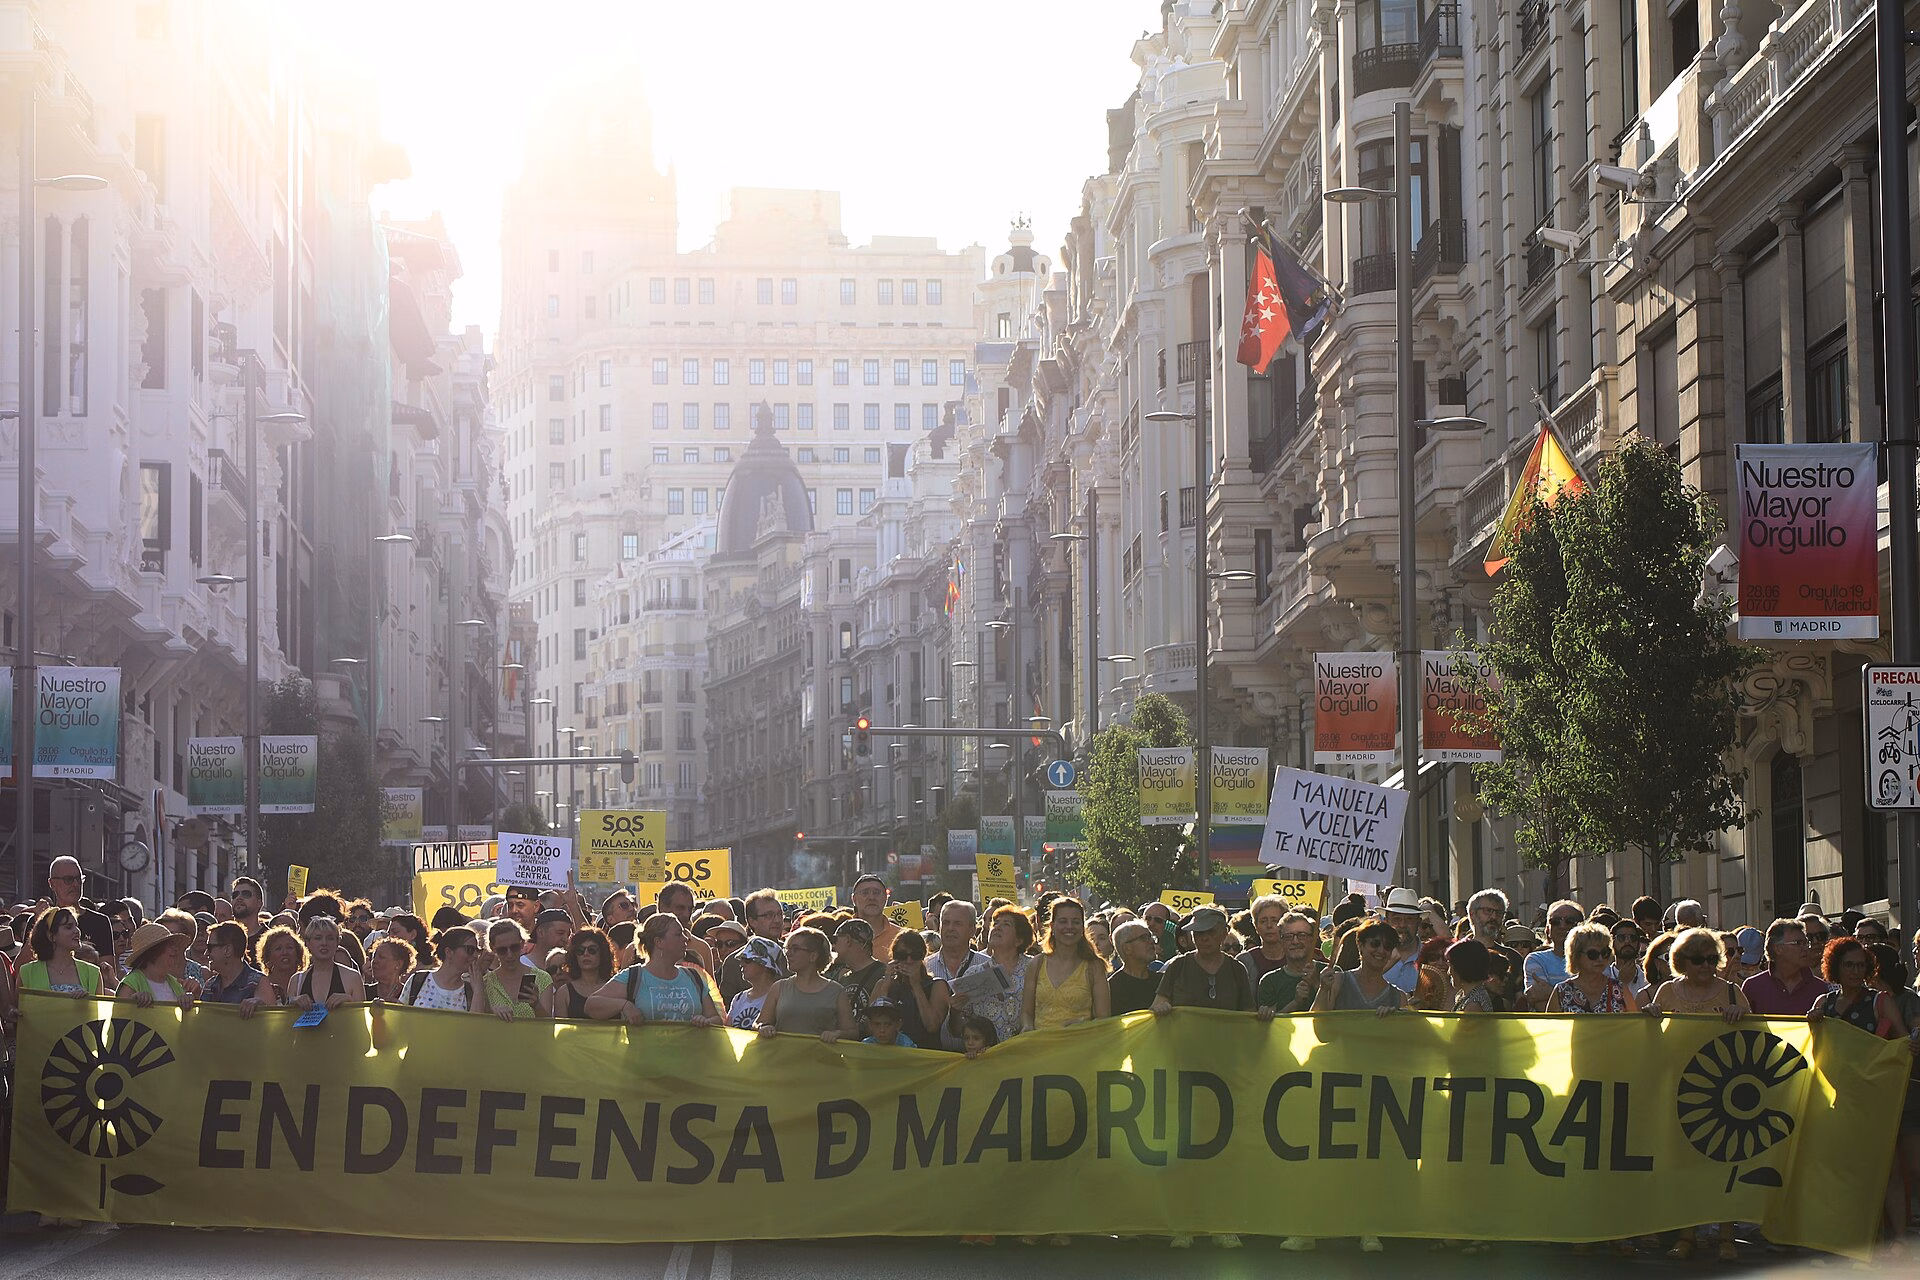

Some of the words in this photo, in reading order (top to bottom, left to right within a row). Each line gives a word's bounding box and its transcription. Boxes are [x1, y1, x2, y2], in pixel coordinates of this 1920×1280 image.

[1743, 460, 1855, 488] Nuestro
[1745, 490, 1832, 525] Mayor
[1749, 519, 1847, 555] Orgullo
[1746, 584, 1780, 598] 28.06
[1799, 584, 1848, 600] Orgullo
[1850, 584, 1864, 597] 19
[1746, 599, 1779, 611] 07.07
[1824, 598, 1872, 611] Madrid
[1790, 621, 1841, 632] MADRID
[1318, 662, 1383, 679] Nuestro
[1425, 660, 1492, 677] Nuero
[41, 676, 106, 693] Nuestro
[1873, 671, 1920, 685] PRECAU
[1319, 679, 1370, 699] Mayor
[40, 693, 92, 713] Mayor
[1319, 696, 1378, 716] Orgullo
[40, 709, 99, 730] Orgullo
[69, 746, 98, 757] Orgullo
[190, 743, 236, 755] Nuestro
[263, 742, 308, 754] Nuestro
[84, 755, 112, 763] Madrid
[190, 755, 227, 769] Mayor
[263, 754, 299, 768] Mayor
[1140, 754, 1186, 766] Nuestro
[1213, 753, 1259, 766] Nuestro
[1345, 753, 1376, 761] MADRID
[63, 767, 94, 775] MADRID
[190, 767, 232, 781] Orgullo
[263, 765, 305, 780] Orgullo
[1141, 766, 1177, 780] Mayor
[1213, 765, 1250, 779] Mayor
[1142, 777, 1184, 791] Orgullo
[1213, 776, 1255, 791] Orgullo
[1047, 795, 1079, 804] Nuestro
[1292, 779, 1388, 819] MANUELA
[1047, 804, 1075, 814] Mayor
[602, 814, 645, 836] SOS
[1047, 813, 1079, 824] Orgullo
[1300, 807, 1380, 843] VUELVE
[1026, 827, 1046, 835] Mayo
[509, 843, 560, 858] 220.000
[591, 838, 654, 849] MALASAÑA
[413, 843, 468, 876] CAMBIAR
[469, 843, 498, 862] EL
[515, 871, 552, 881] CENTRAL
[518, 864, 550, 874] MADRID
[498, 877, 568, 889] change.org/MadridCentral
[441, 882, 500, 912] SOS
[778, 892, 804, 901] MENOS
[805, 890, 834, 899] COCHES
[1272, 882, 1306, 900] SOS
[1172, 895, 1201, 910] SOS
[198, 1079, 321, 1172] EN
[343, 1085, 785, 1184] DEFENSA
[892, 1069, 1234, 1171] MADRID
[1263, 1071, 1654, 1178] CENTRAL
